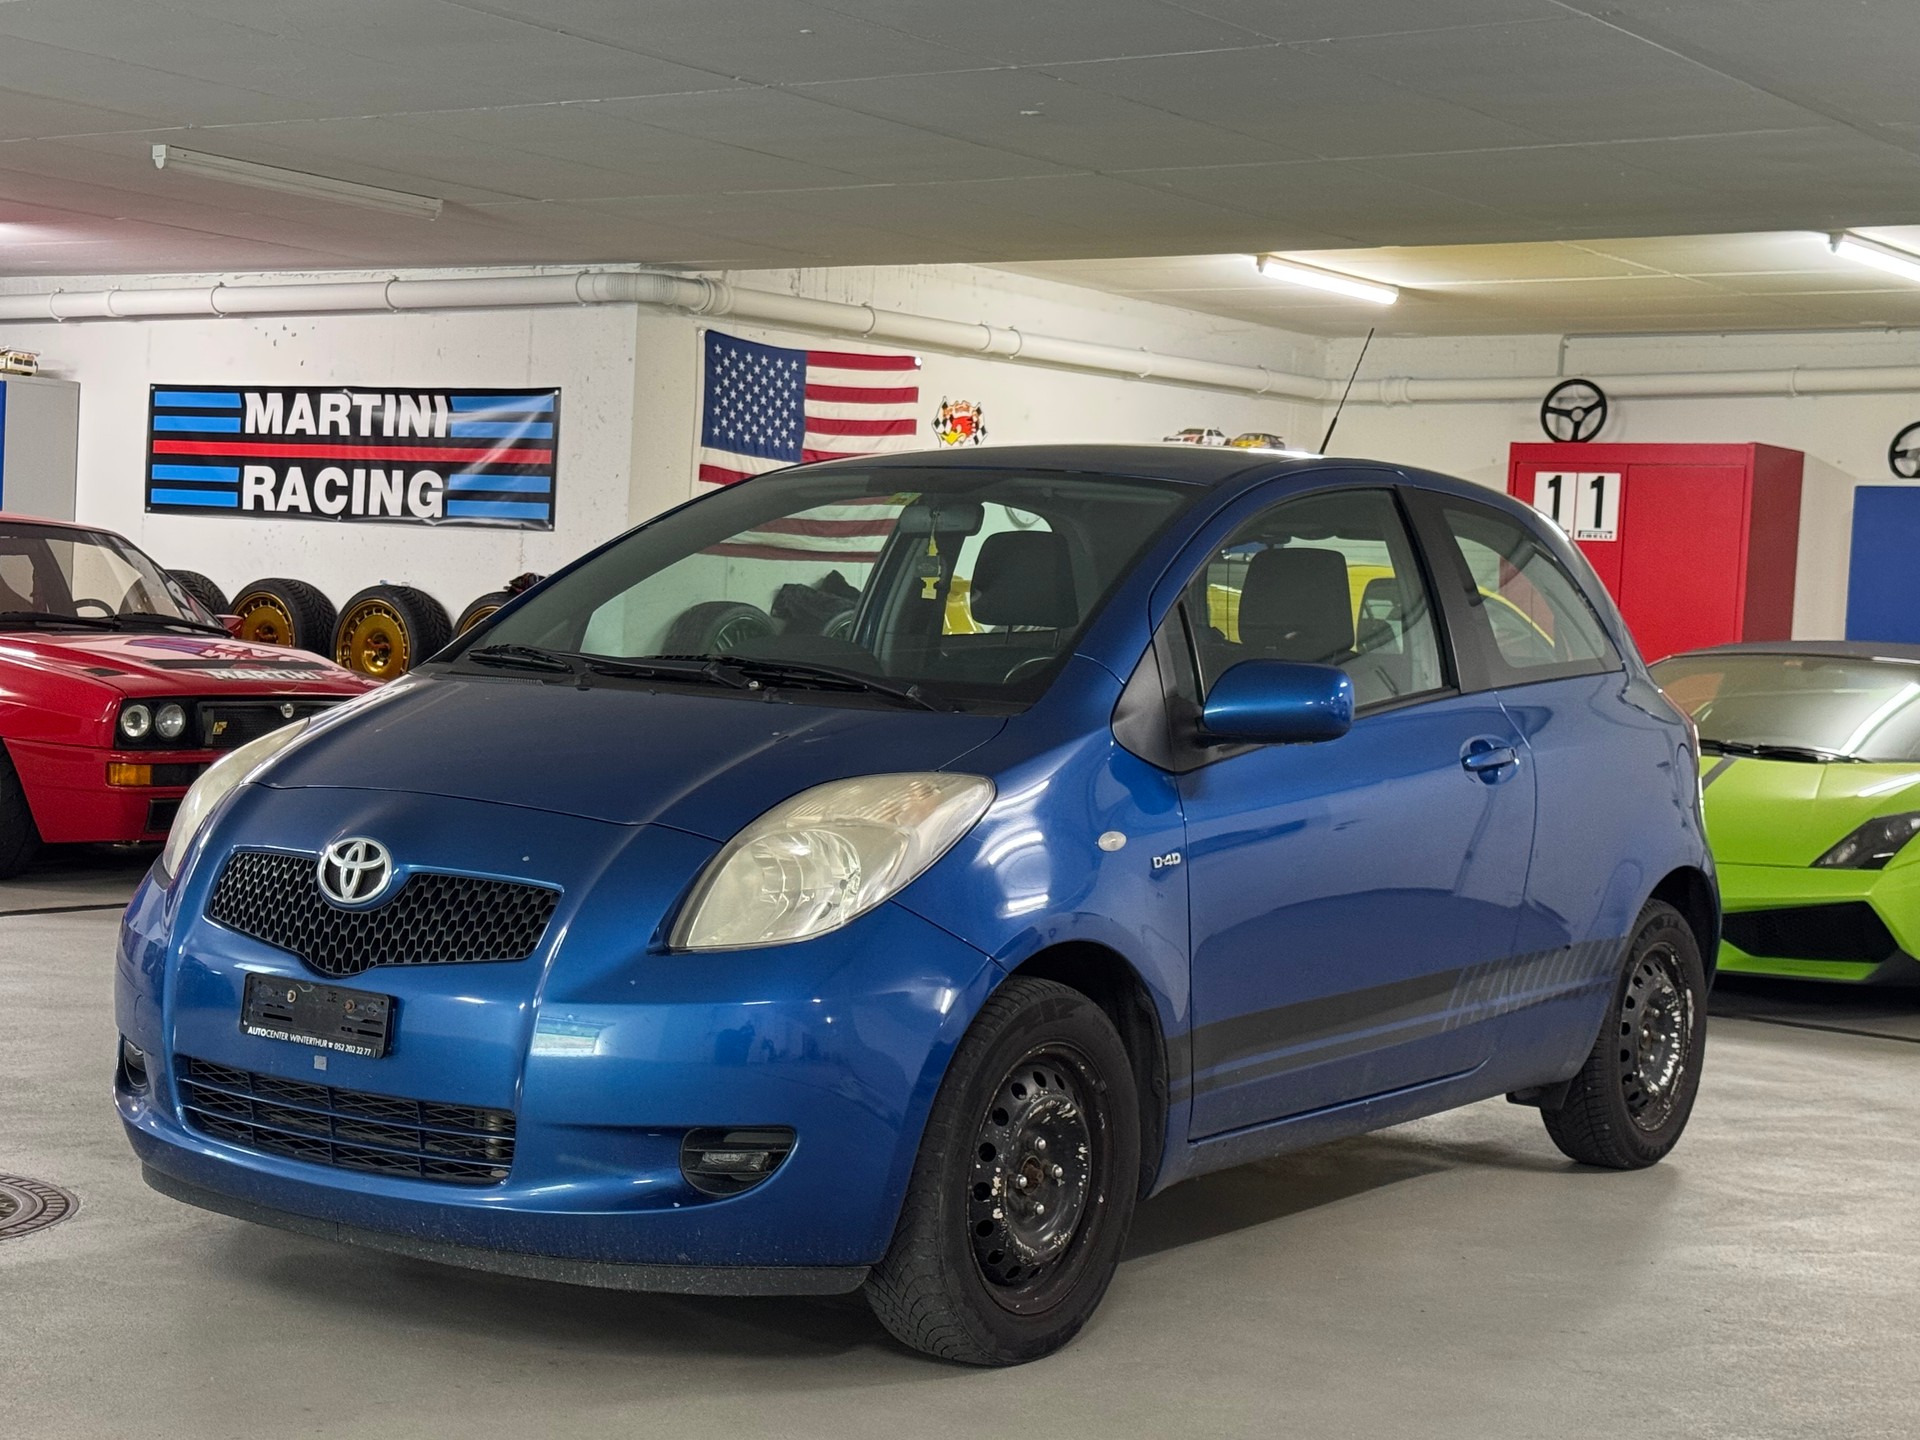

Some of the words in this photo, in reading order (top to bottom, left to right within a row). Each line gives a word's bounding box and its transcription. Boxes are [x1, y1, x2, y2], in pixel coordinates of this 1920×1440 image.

[244, 392, 448, 438] MARTINI
[242, 465, 444, 518] RACING
[206, 669, 323, 681] MARTINI
[247, 1026, 288, 1041] AUTOCENTER
[290, 1033, 328, 1047] WINTERTHUR
[334, 1042, 344, 1051] 052
[345, 1044, 355, 1054] 202
[355, 1046, 364, 1055] 22
[364, 1048, 372, 1056] 77
